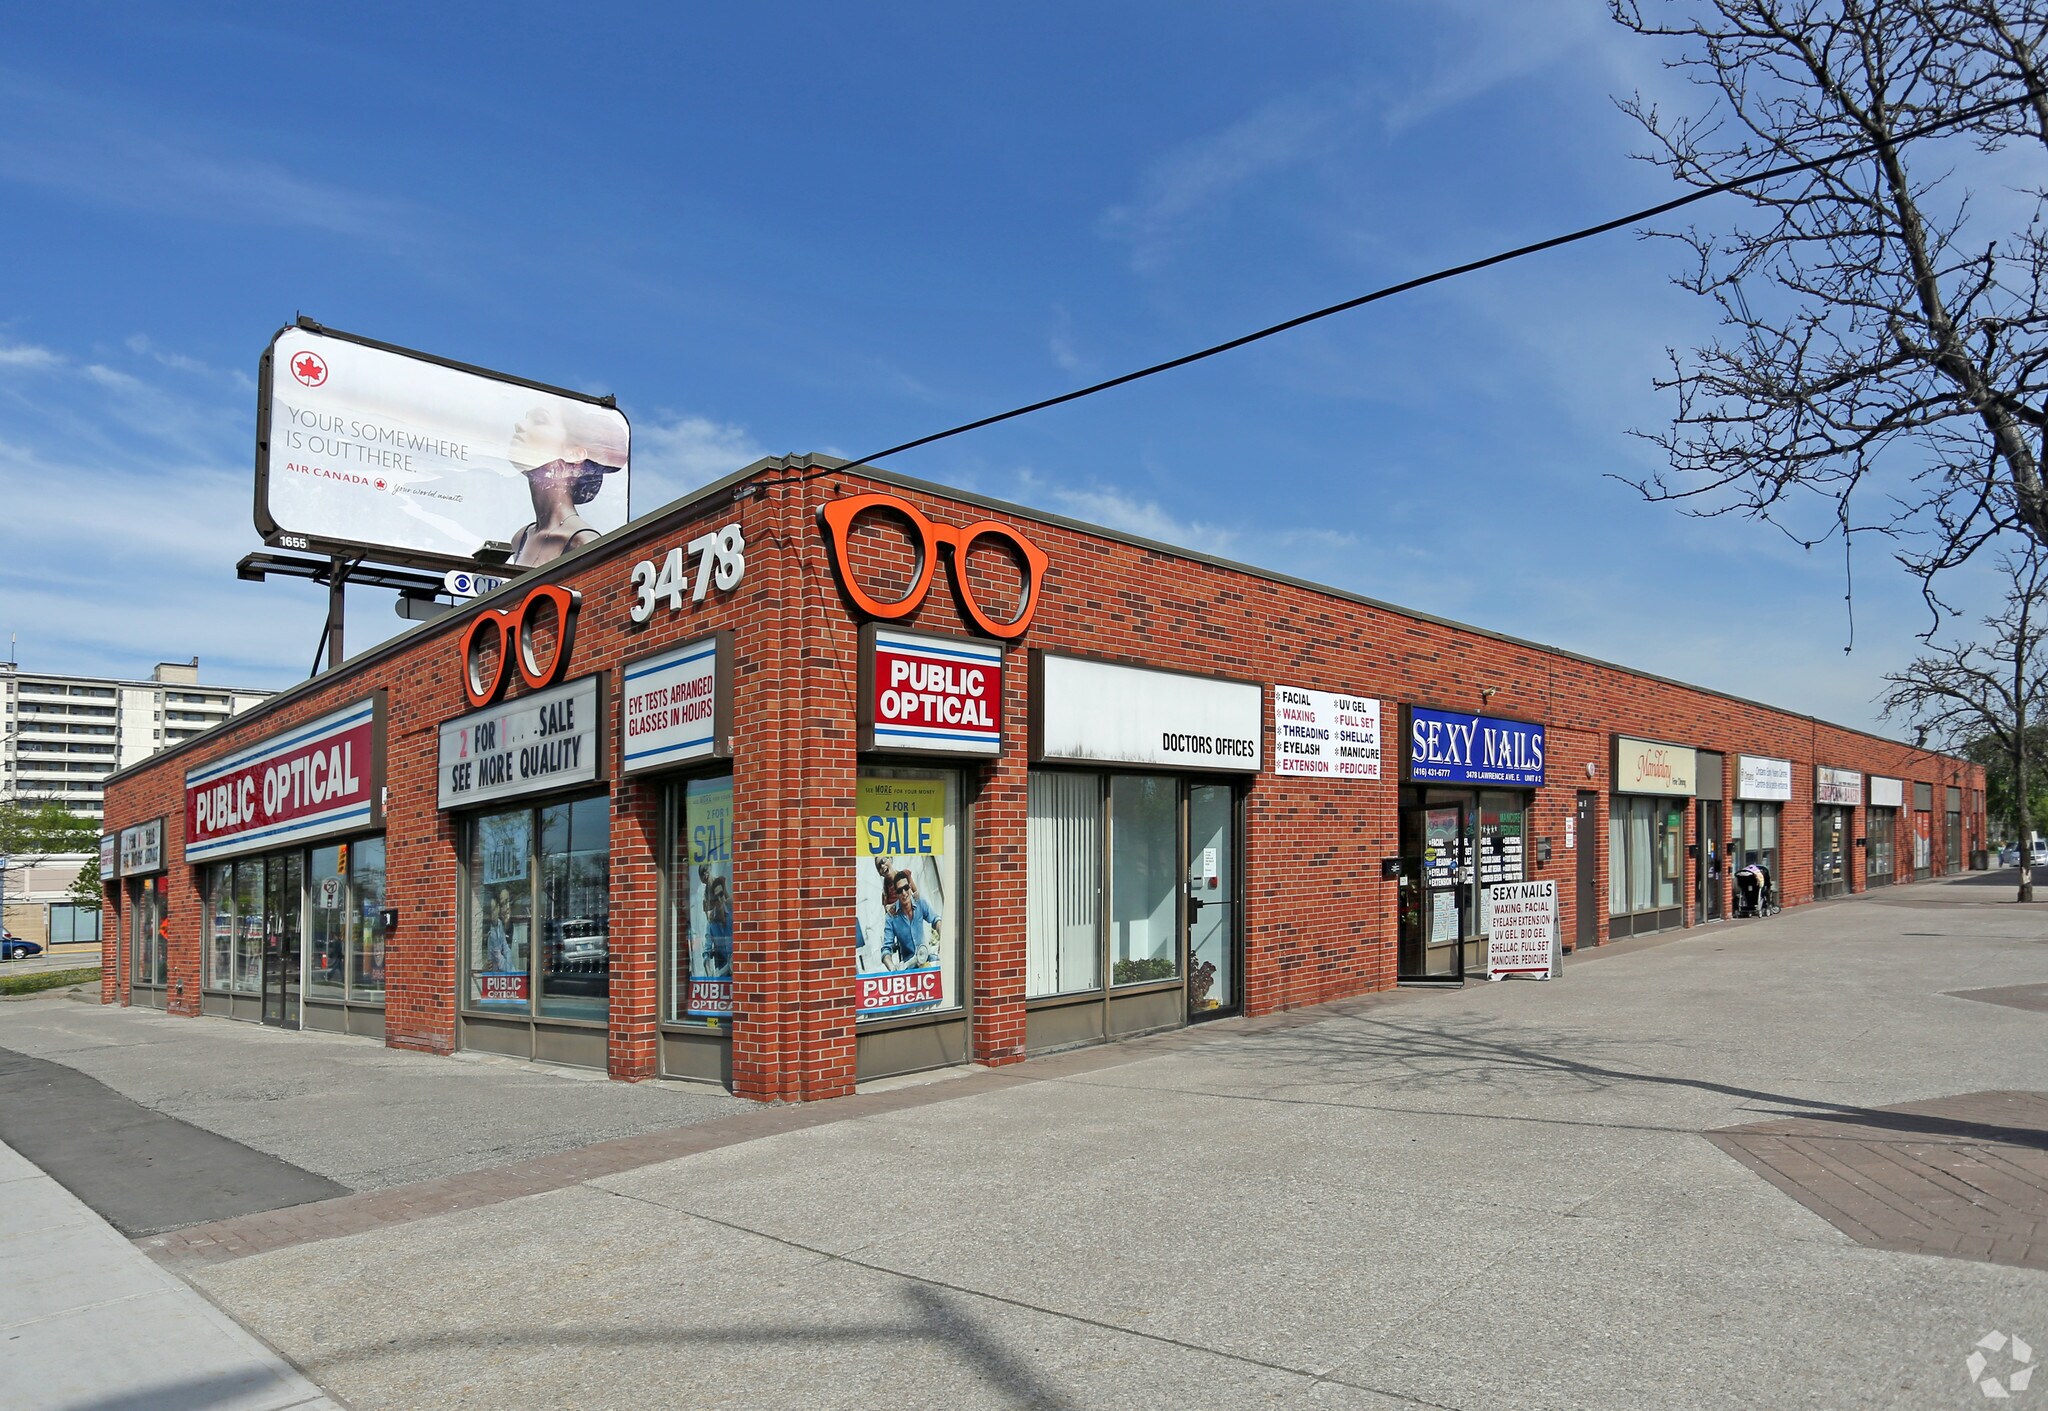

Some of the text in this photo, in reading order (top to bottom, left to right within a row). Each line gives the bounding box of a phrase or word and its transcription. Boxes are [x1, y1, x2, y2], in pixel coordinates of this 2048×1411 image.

[289, 406, 469, 461] YOUR SOMEWHERE
[286, 430, 417, 473] IS OUT THERE.
[286, 462, 369, 486] AIR CANADA
[392, 483, 411, 496] Your
[413, 489, 437, 498] world
[280, 536, 307, 549] 1655
[630, 523, 745, 623] 3478
[891, 659, 985, 697] PUBLIC
[629, 675, 713, 715] EYE TESTS ARRANGED
[1282, 691, 1311, 706] FACIAL
[880, 689, 994, 726] OPTICAL
[1339, 699, 1367, 713] UV GEL
[629, 698, 712, 737] GLASSES IN HOURS
[1282, 708, 1316, 723] WAXING
[1340, 715, 1374, 729] FULL SET
[1283, 725, 1329, 740] THREADING
[1340, 730, 1374, 744] SHELLAC
[459, 729, 468, 758] 2
[474, 724, 495, 754] FOR
[1162, 732, 1254, 758] DOCTORS OFFICES
[1283, 741, 1320, 755] EYELASH
[1411, 717, 1543, 771] SEXY NAILS
[1340, 746, 1379, 759] MANICURE
[452, 735, 582, 792] SEE MORE QUALITY
[1283, 759, 1329, 772] EXTENSION
[1340, 763, 1377, 775] PEDICURE
[1413, 767, 1427, 777] (416)
[1466, 771, 1477, 779] 3478
[1478, 771, 1504, 780] LAWRENCE
[196, 741, 359, 834] PUBLIC OPTICAL
[875, 785, 892, 794] MORE
[707, 807, 729, 820] 2 FOR 1
[885, 801, 916, 811] 2 FOR 1
[694, 818, 733, 862] SAL
[867, 812, 932, 855] SALE
[1492, 883, 1552, 900] SEXY NAILS
[1525, 902, 1549, 912] FACIAL
[1493, 915, 1550, 927] EYELASH EXTENSION
[1495, 930, 1503, 940] UV
[1521, 929, 1532, 938] BIO
[1534, 928, 1546, 938] GEL
[1522, 942, 1535, 951] FULL
[1538, 941, 1549, 951] SET
[1491, 954, 1548, 965] MANICURE PEDICURE
[487, 977, 521, 990] PUBLIC
[863, 973, 935, 997] PUBLIC
[863, 991, 934, 1007] OPTICAL
